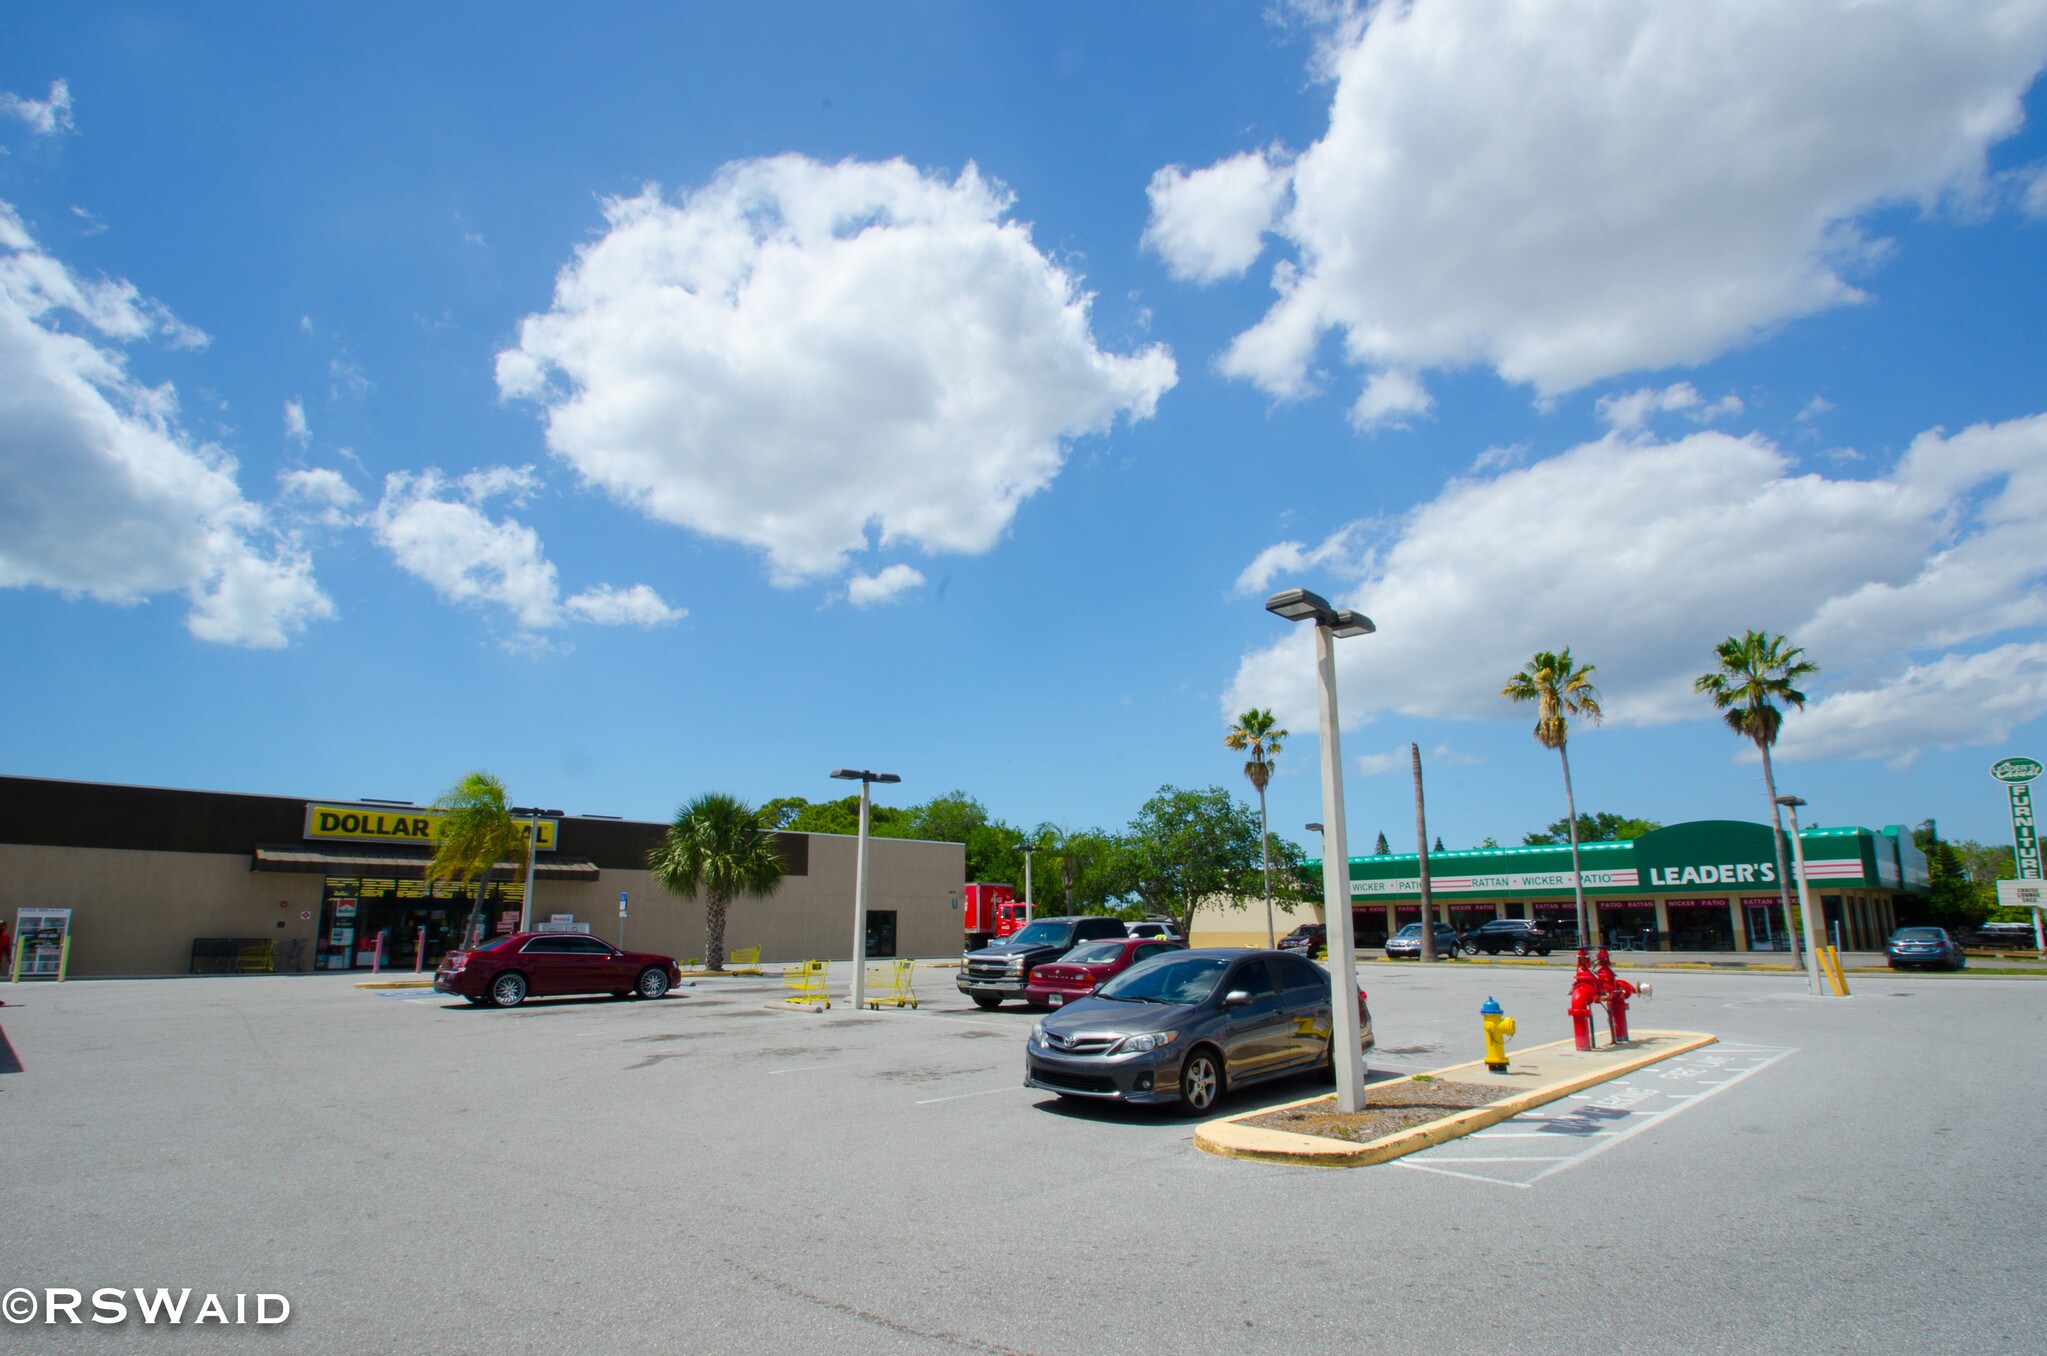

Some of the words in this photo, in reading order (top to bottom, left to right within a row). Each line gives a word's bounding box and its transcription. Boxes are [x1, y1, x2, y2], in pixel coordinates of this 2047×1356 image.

[319, 812, 430, 838] DOLLAR
[2012, 786, 2039, 879] FURNITURE
[1472, 877, 1509, 888] RATTAN
[1522, 875, 1563, 886] WICKER
[1650, 862, 1776, 886] LEADER'S
[1353, 883, 1385, 891] WICKER
